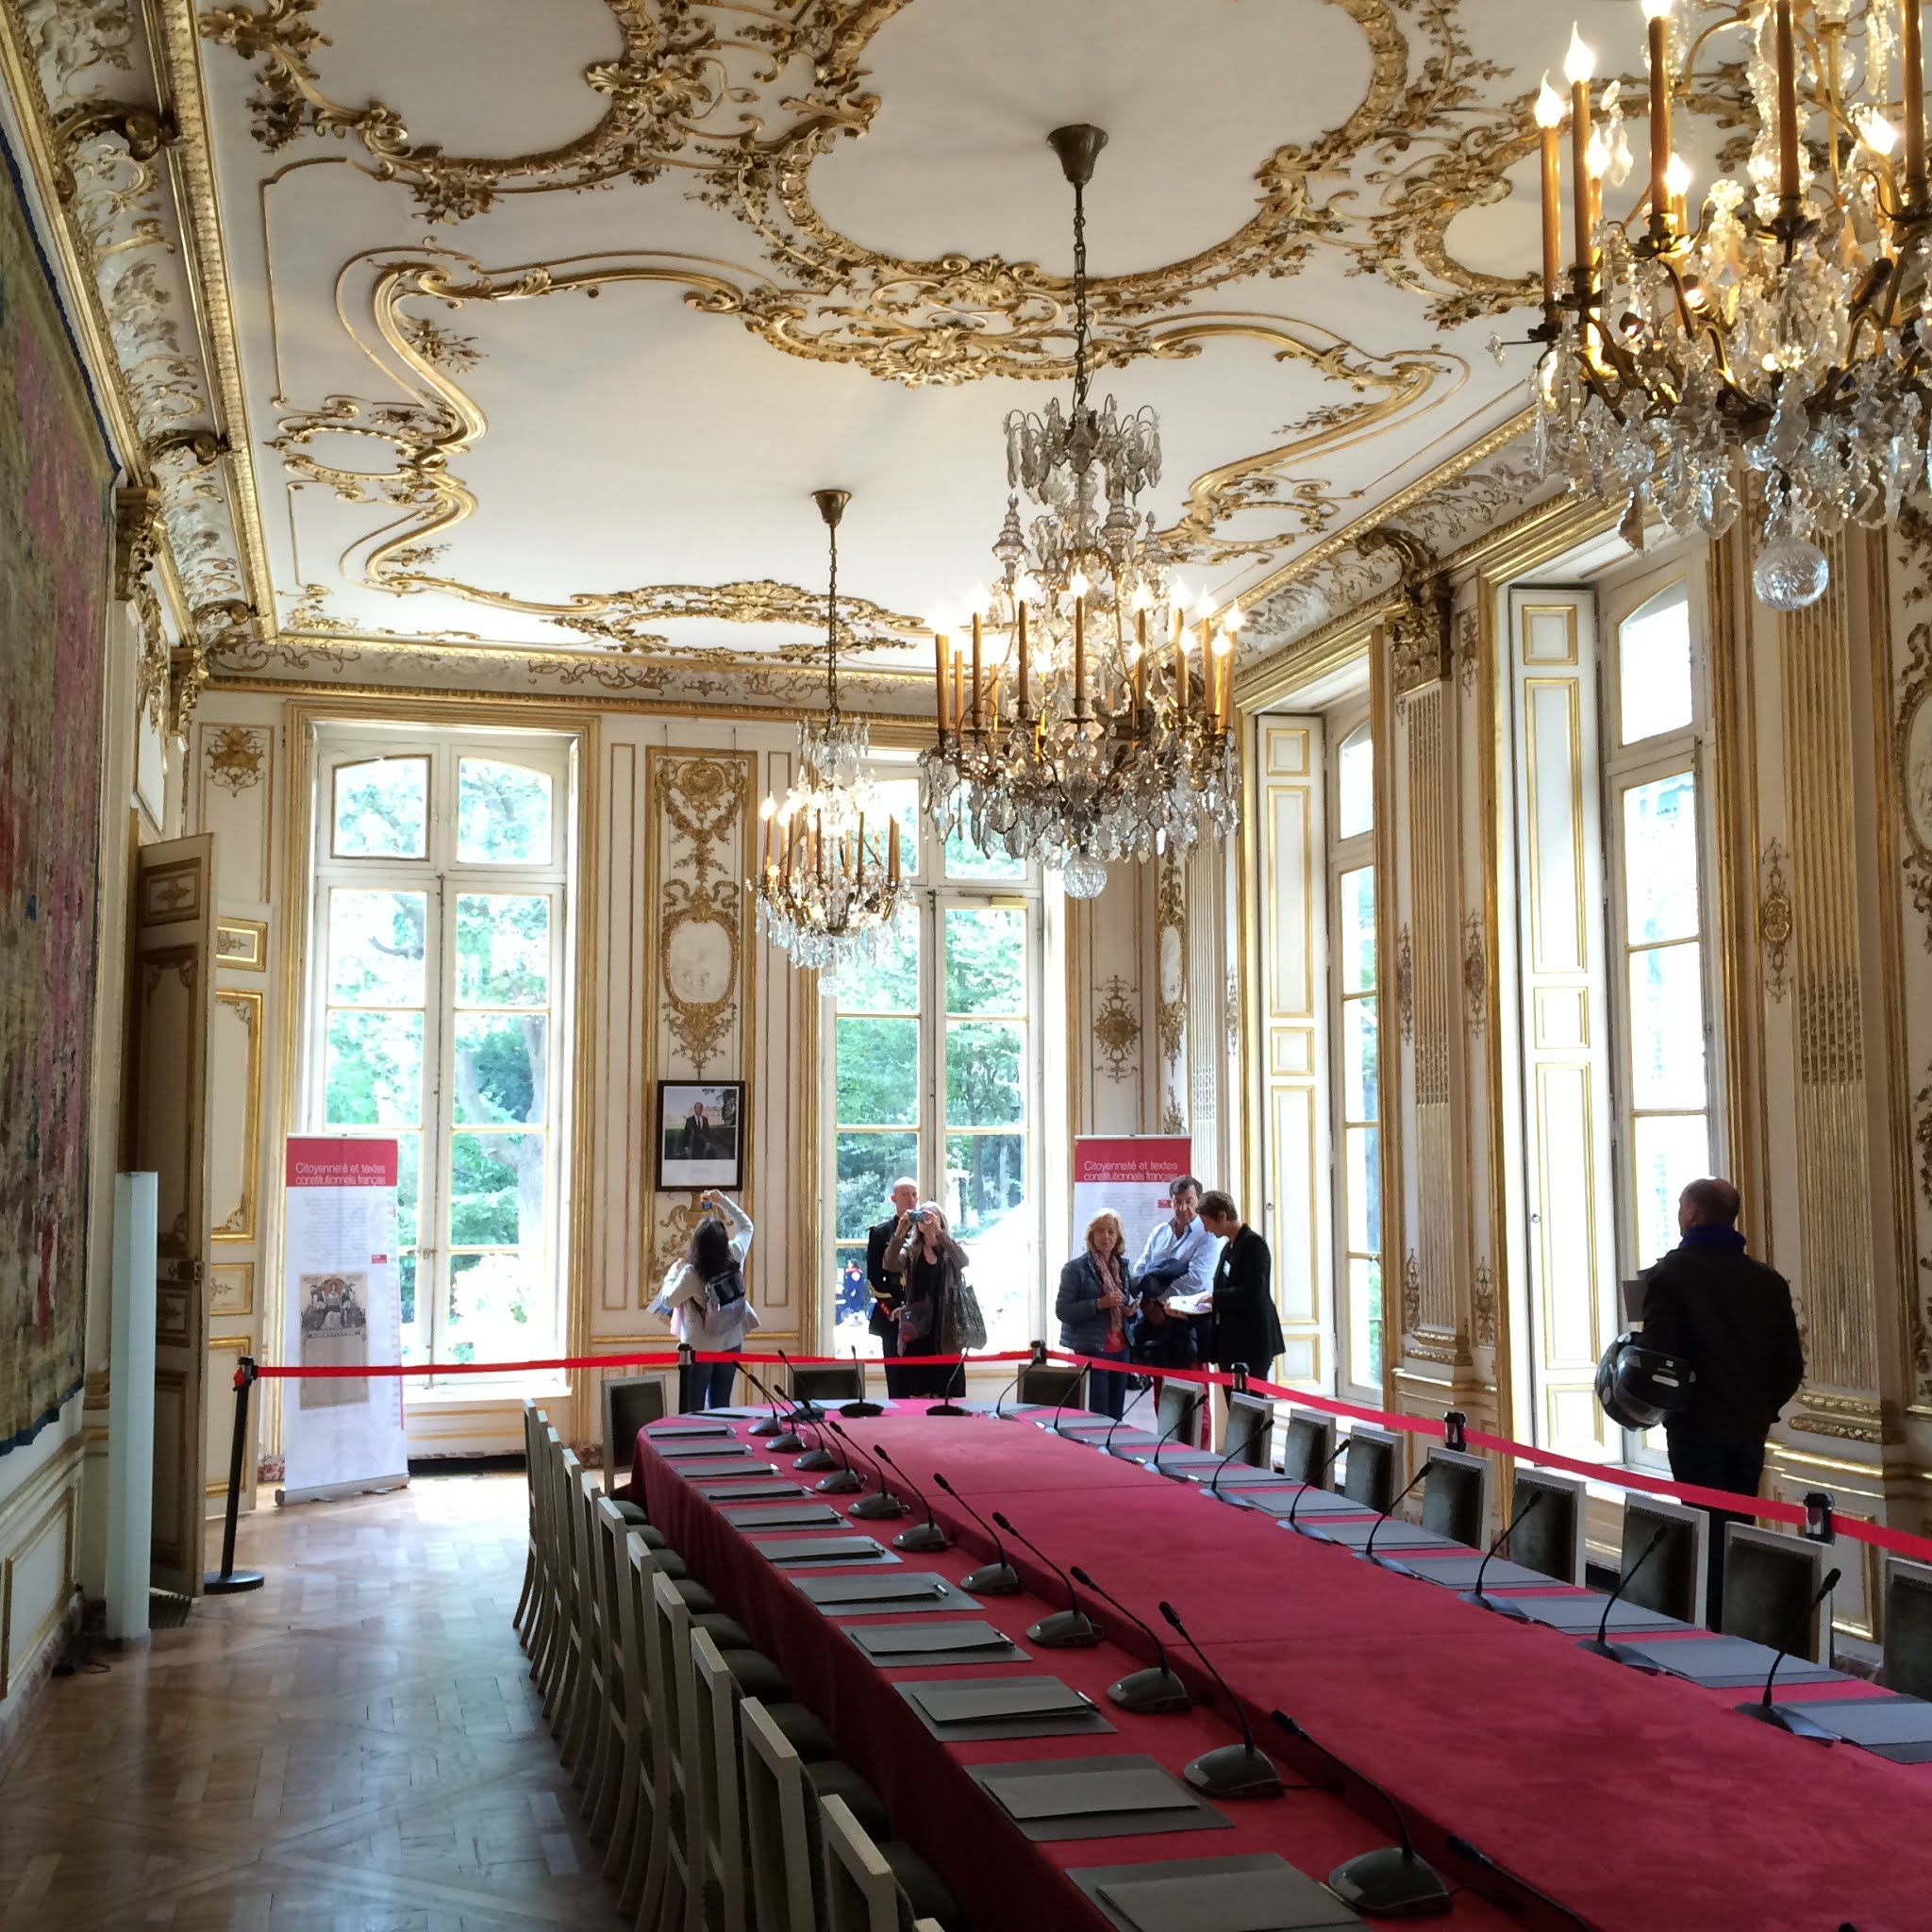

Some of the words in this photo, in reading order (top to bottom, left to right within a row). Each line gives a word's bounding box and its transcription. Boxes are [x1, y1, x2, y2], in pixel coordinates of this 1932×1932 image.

[295, 1162, 348, 1175] Citoyenneté
[350, 1163, 359, 1174] et
[361, 1163, 385, 1174] textes
[1084, 1160, 1136, 1172] Citoyenneté
[1139, 1161, 1147, 1170] et
[1150, 1161, 1177, 1171] textes
[358, 1174, 386, 1187] français
